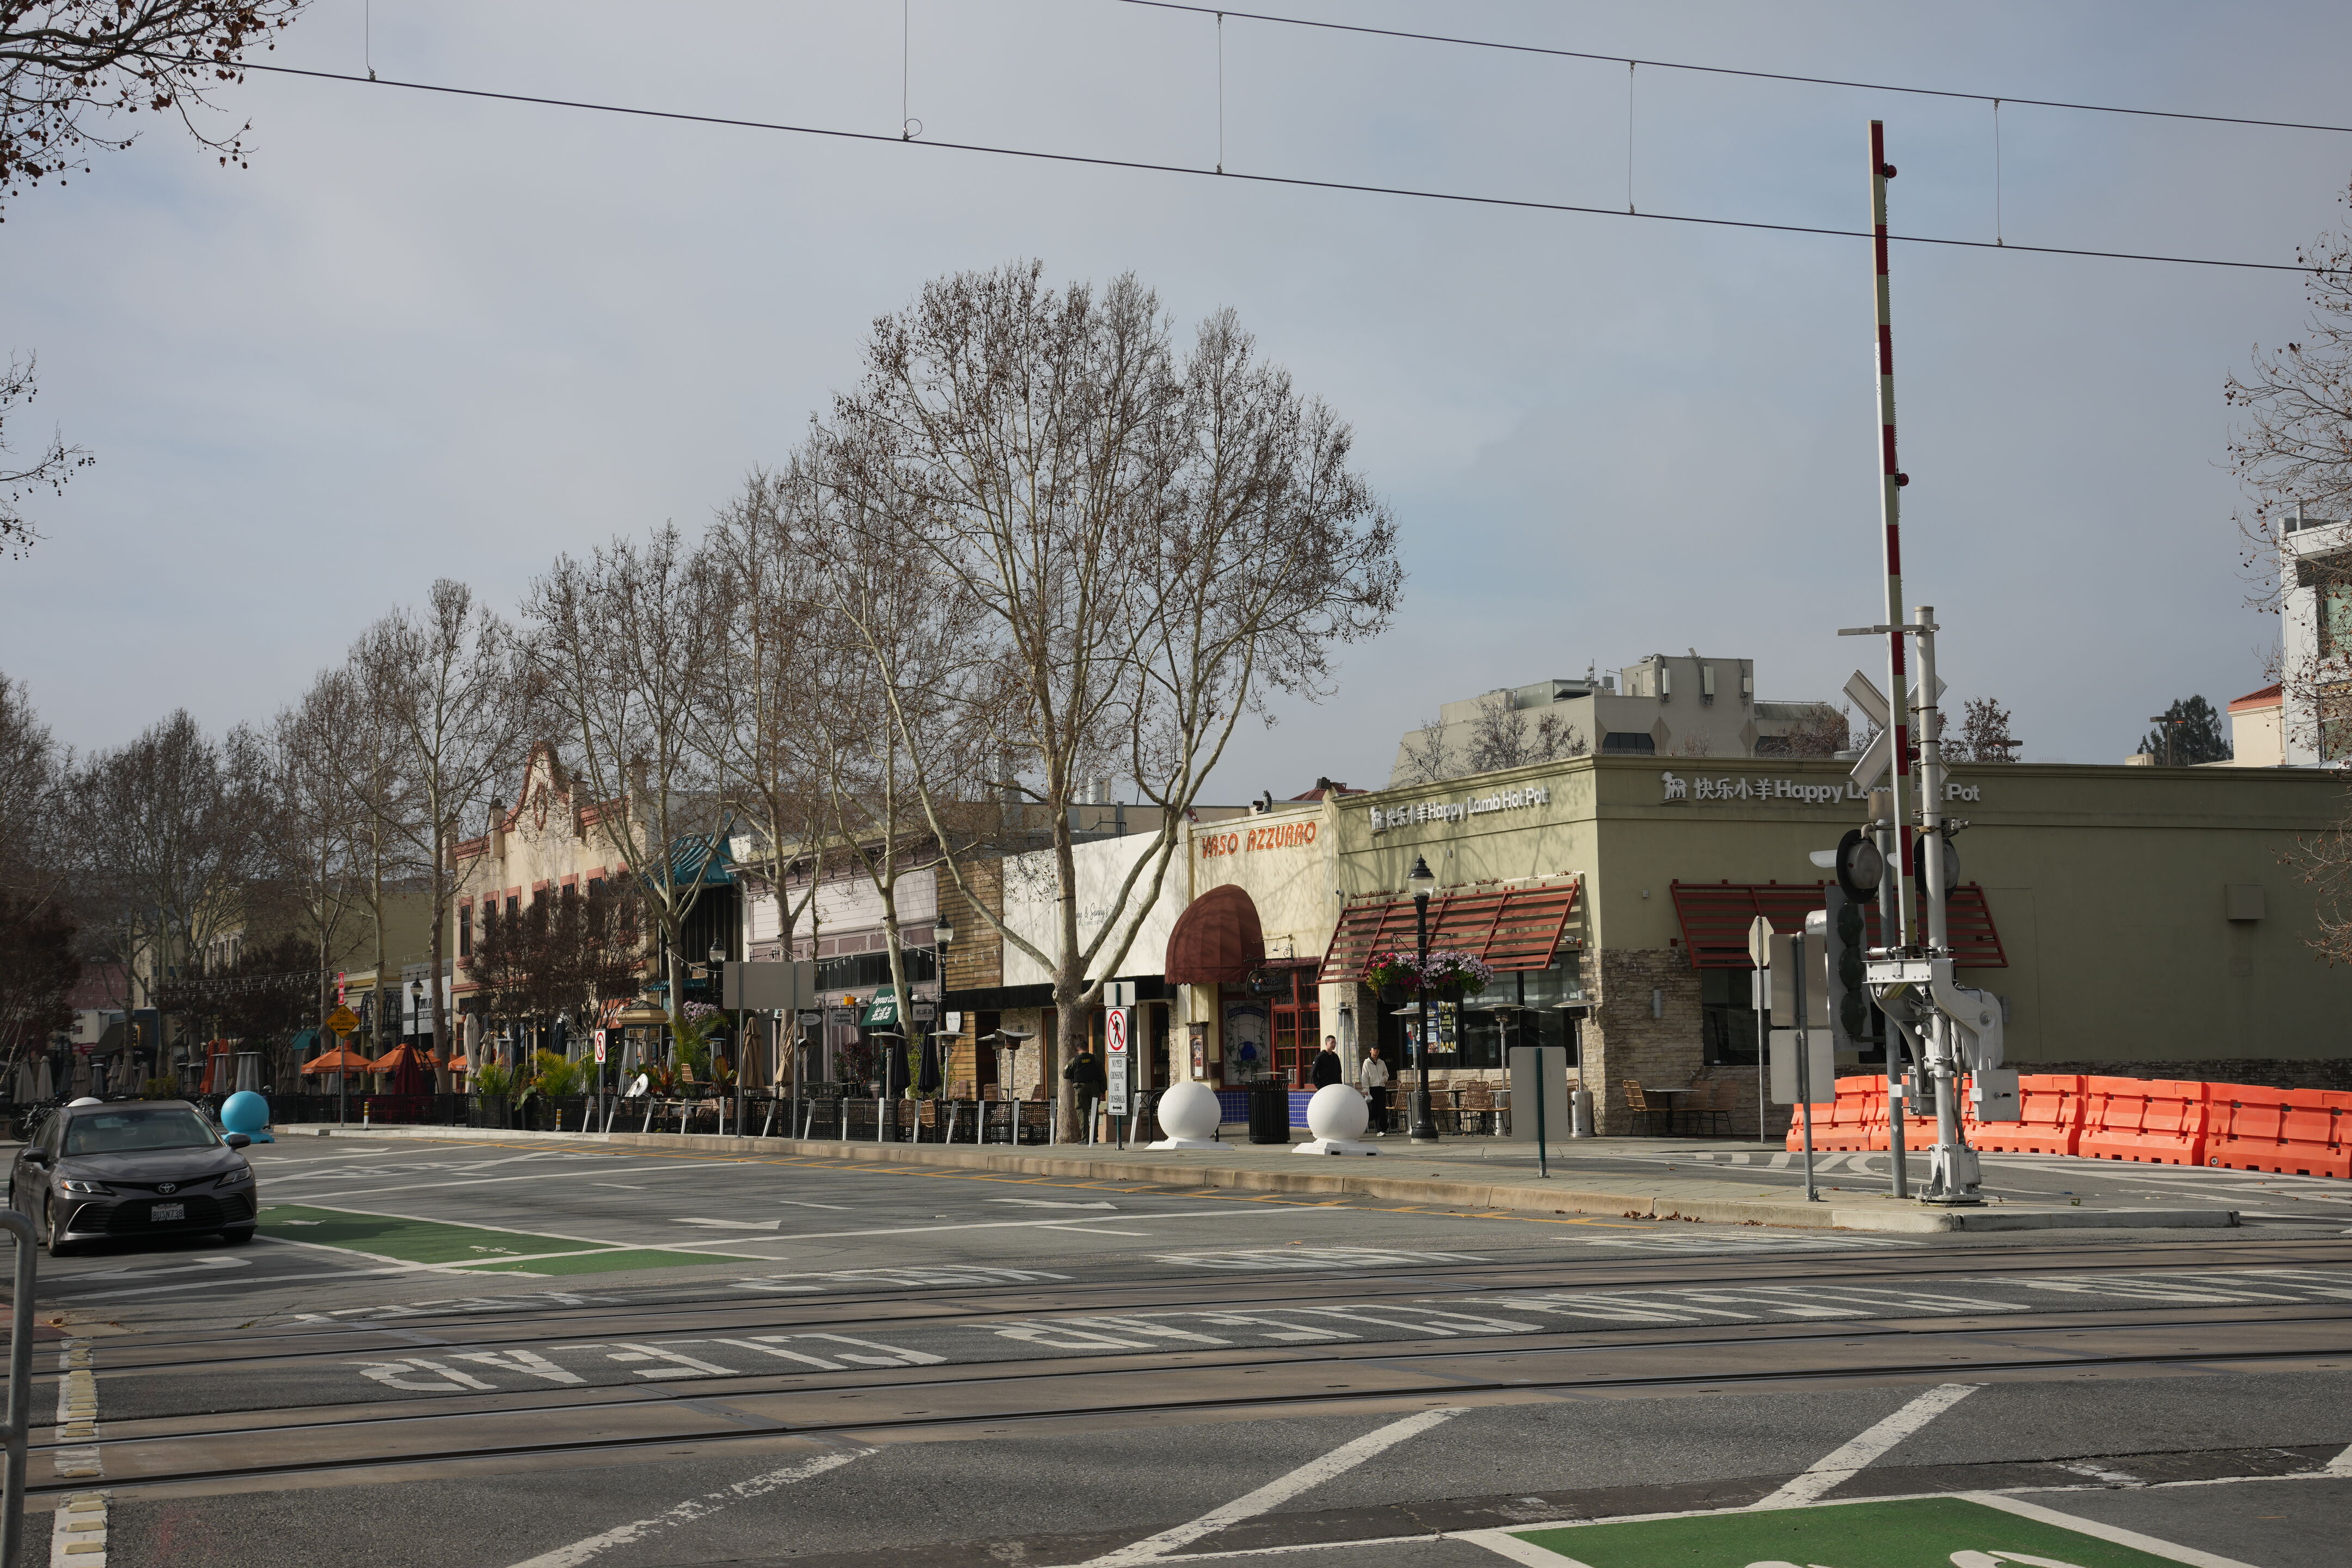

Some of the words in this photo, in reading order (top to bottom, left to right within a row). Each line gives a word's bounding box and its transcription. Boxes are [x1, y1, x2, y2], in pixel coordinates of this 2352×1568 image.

[1693, 777, 1774, 800] 快乐小羊
[1773, 779, 1844, 804] Happy
[1945, 783, 1980, 801] Pot
[1386, 801, 1428, 828] 快乐小羊
[1427, 801, 1467, 822] Happy
[1467, 792, 1501, 814] Lamb
[1502, 790, 1526, 809] Hot
[1525, 786, 1550, 805] Pot
[1202, 832, 1239, 859] VASO
[1246, 821, 1316, 852] AZZURRO
[1110, 1071, 1124, 1080] CROSSING
[1111, 1059, 1116, 1068] NO
[1109, 1095, 1125, 1104] CROSSWALK
[152, 1209, 183, 1220] 8USN738
[958, 1304, 1545, 1349] CLEAR
[338, 1332, 948, 1392] CLEAR
